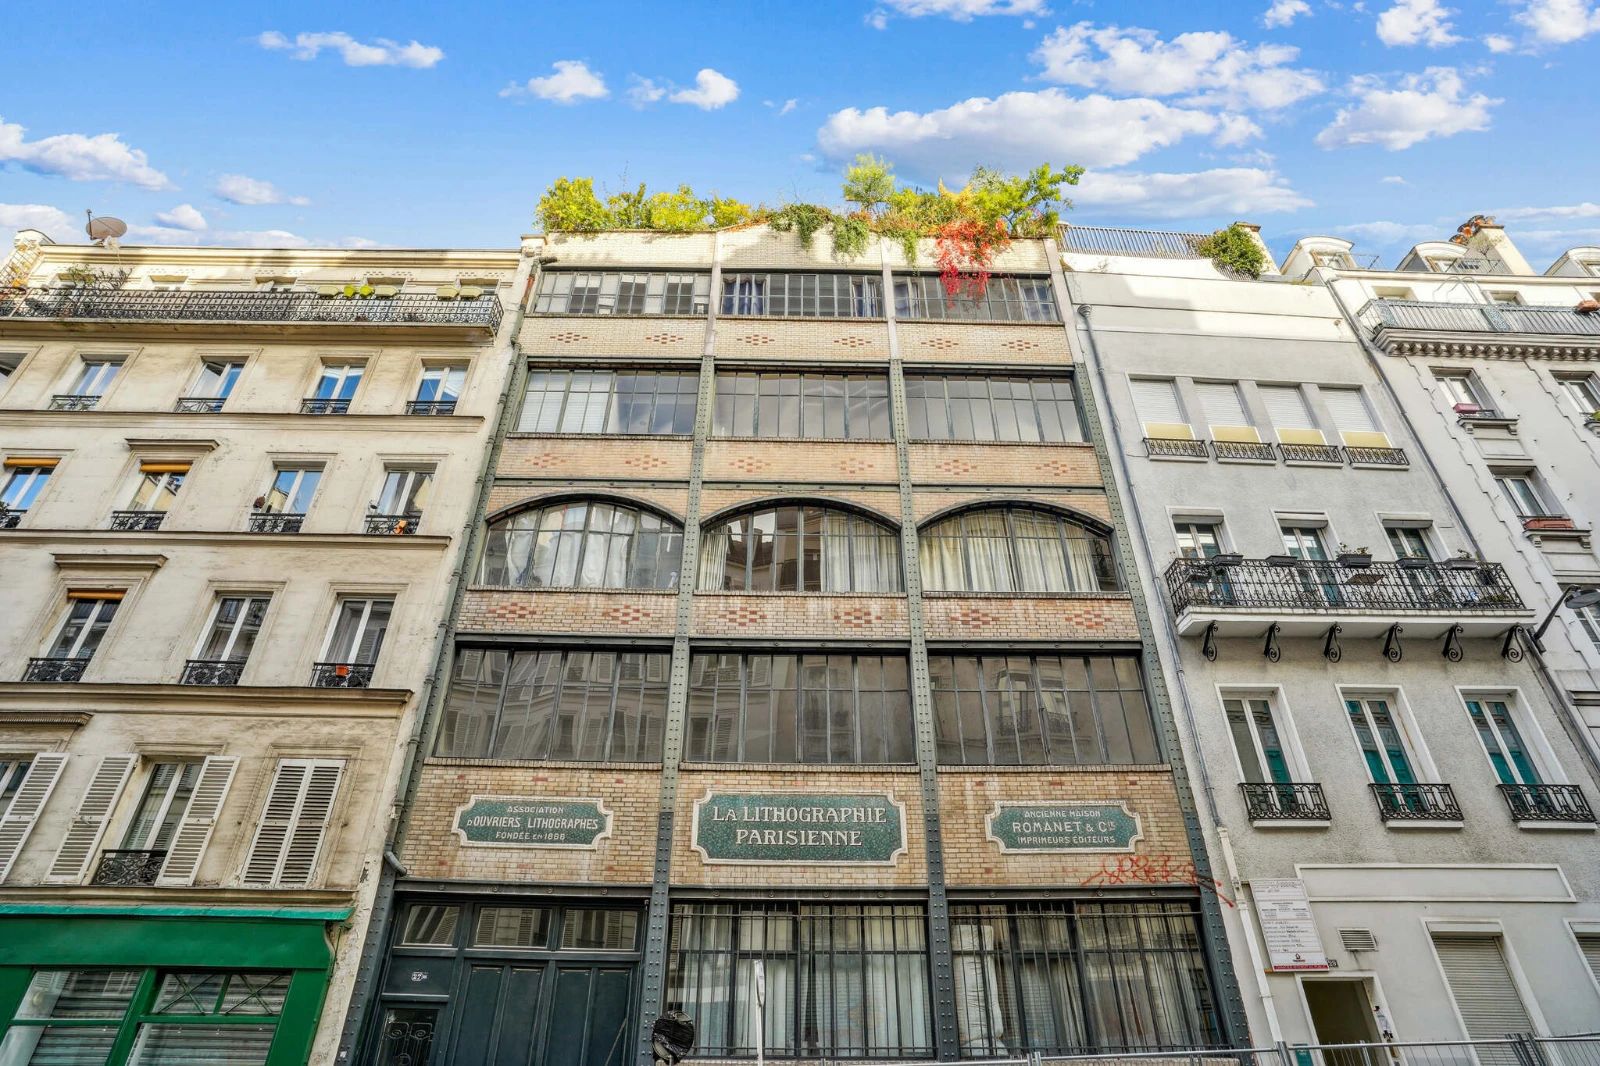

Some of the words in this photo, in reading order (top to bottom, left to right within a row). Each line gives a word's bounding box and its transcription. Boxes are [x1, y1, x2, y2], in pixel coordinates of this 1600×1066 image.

[506, 805, 564, 814] ASSOCIATION
[743, 806, 887, 823] LITHOGRAPHIE
[1024, 810, 1067, 818] ANCIENNE
[1069, 810, 1101, 818] MAISON
[528, 817, 598, 829] LITHOGRAPHES
[1012, 821, 1081, 833] ROMANET
[1085, 823, 1094, 832] &
[735, 829, 862, 846] PARISIENNE
[1017, 836, 1070, 844] IMPRIMEURS
